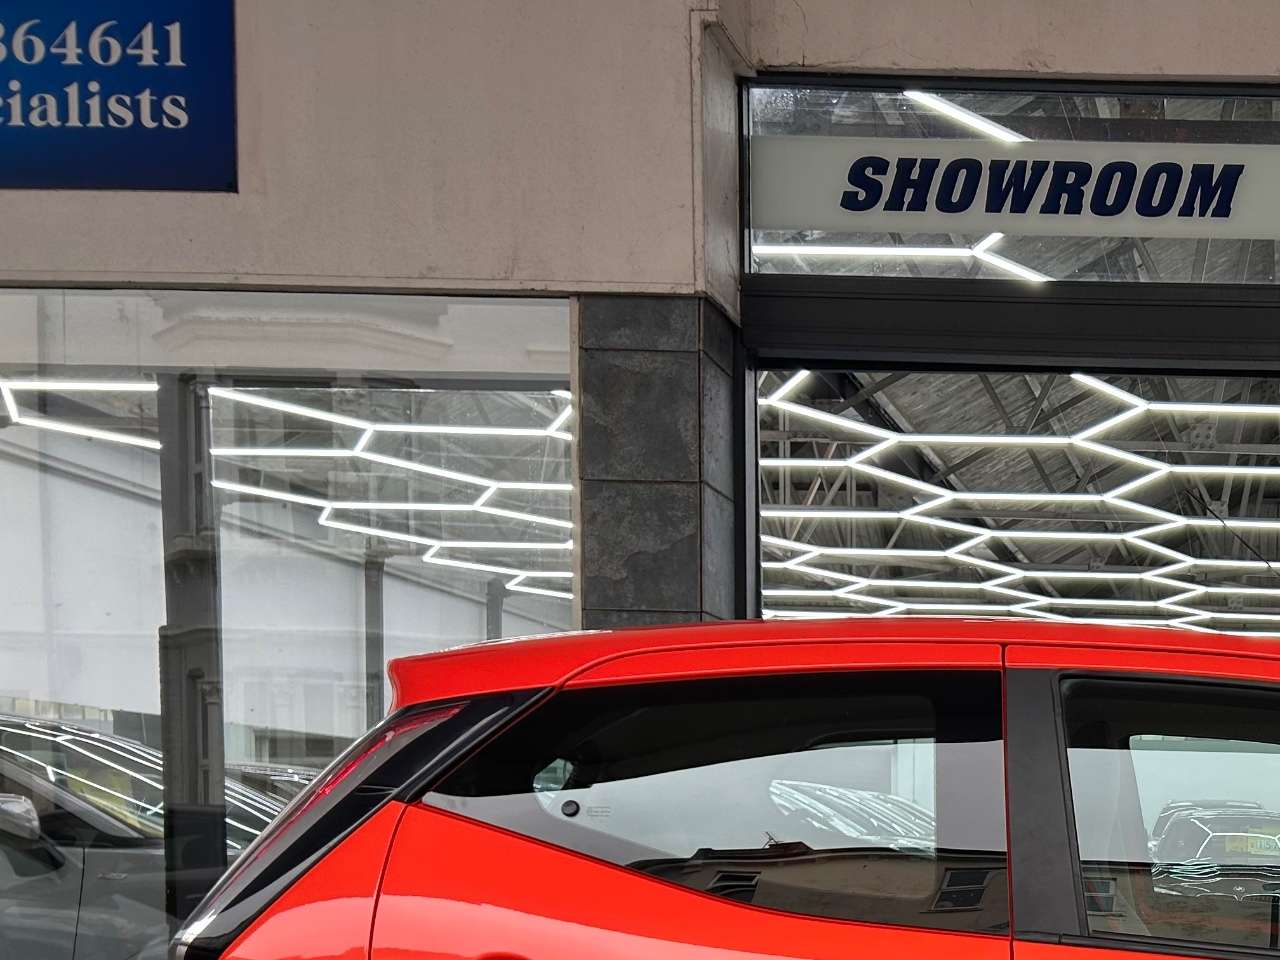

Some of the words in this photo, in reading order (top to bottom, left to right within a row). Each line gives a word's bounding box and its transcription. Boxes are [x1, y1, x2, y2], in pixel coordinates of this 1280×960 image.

[0, 19, 187, 66] 64641
[0, 80, 189, 129] ialists
[839, 156, 1246, 218] SHOWROOM
